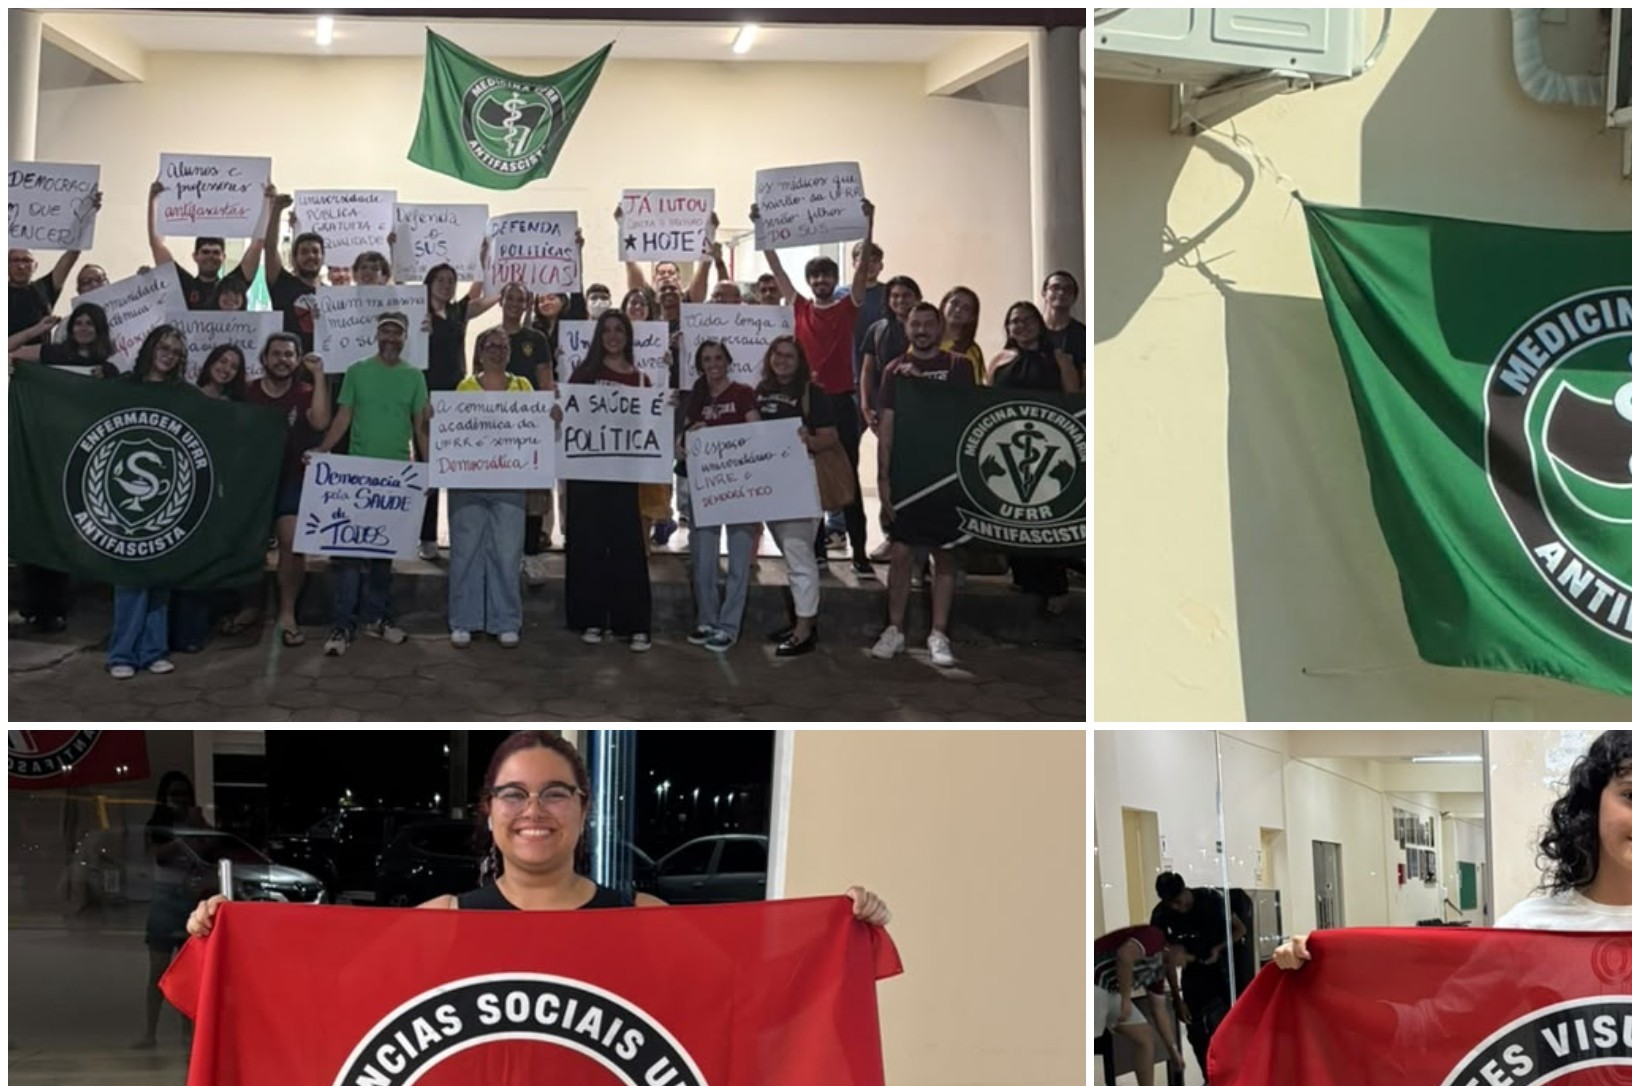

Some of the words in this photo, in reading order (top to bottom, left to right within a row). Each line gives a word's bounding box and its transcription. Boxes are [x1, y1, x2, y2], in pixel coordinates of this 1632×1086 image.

[468, 139, 547, 172] ANTIFASCIST
[8, 169, 98, 193] DEMOCRACIA
[491, 219, 562, 238] DEFENDA
[415, 240, 448, 257] SUS
[735, 312, 776, 336] longa
[456, 400, 547, 414] comunidade
[565, 394, 580, 413] A
[590, 391, 641, 415] SAÚDE
[651, 391, 666, 416] É
[439, 417, 513, 433] acadêmica
[964, 407, 1018, 458] MEDICINA
[79, 411, 182, 453] ENFERMAGEM
[181, 429, 208, 471] UFRR
[565, 425, 660, 452] POLÍTICA
[315, 461, 403, 488] Democracia
[437, 455, 529, 474] Democrática
[695, 472, 738, 491] LIVRE
[1000, 503, 1054, 521] UFRR
[74, 510, 186, 557] ANTIFASCISTA
[476, 990, 646, 1062] SOCIAIS
